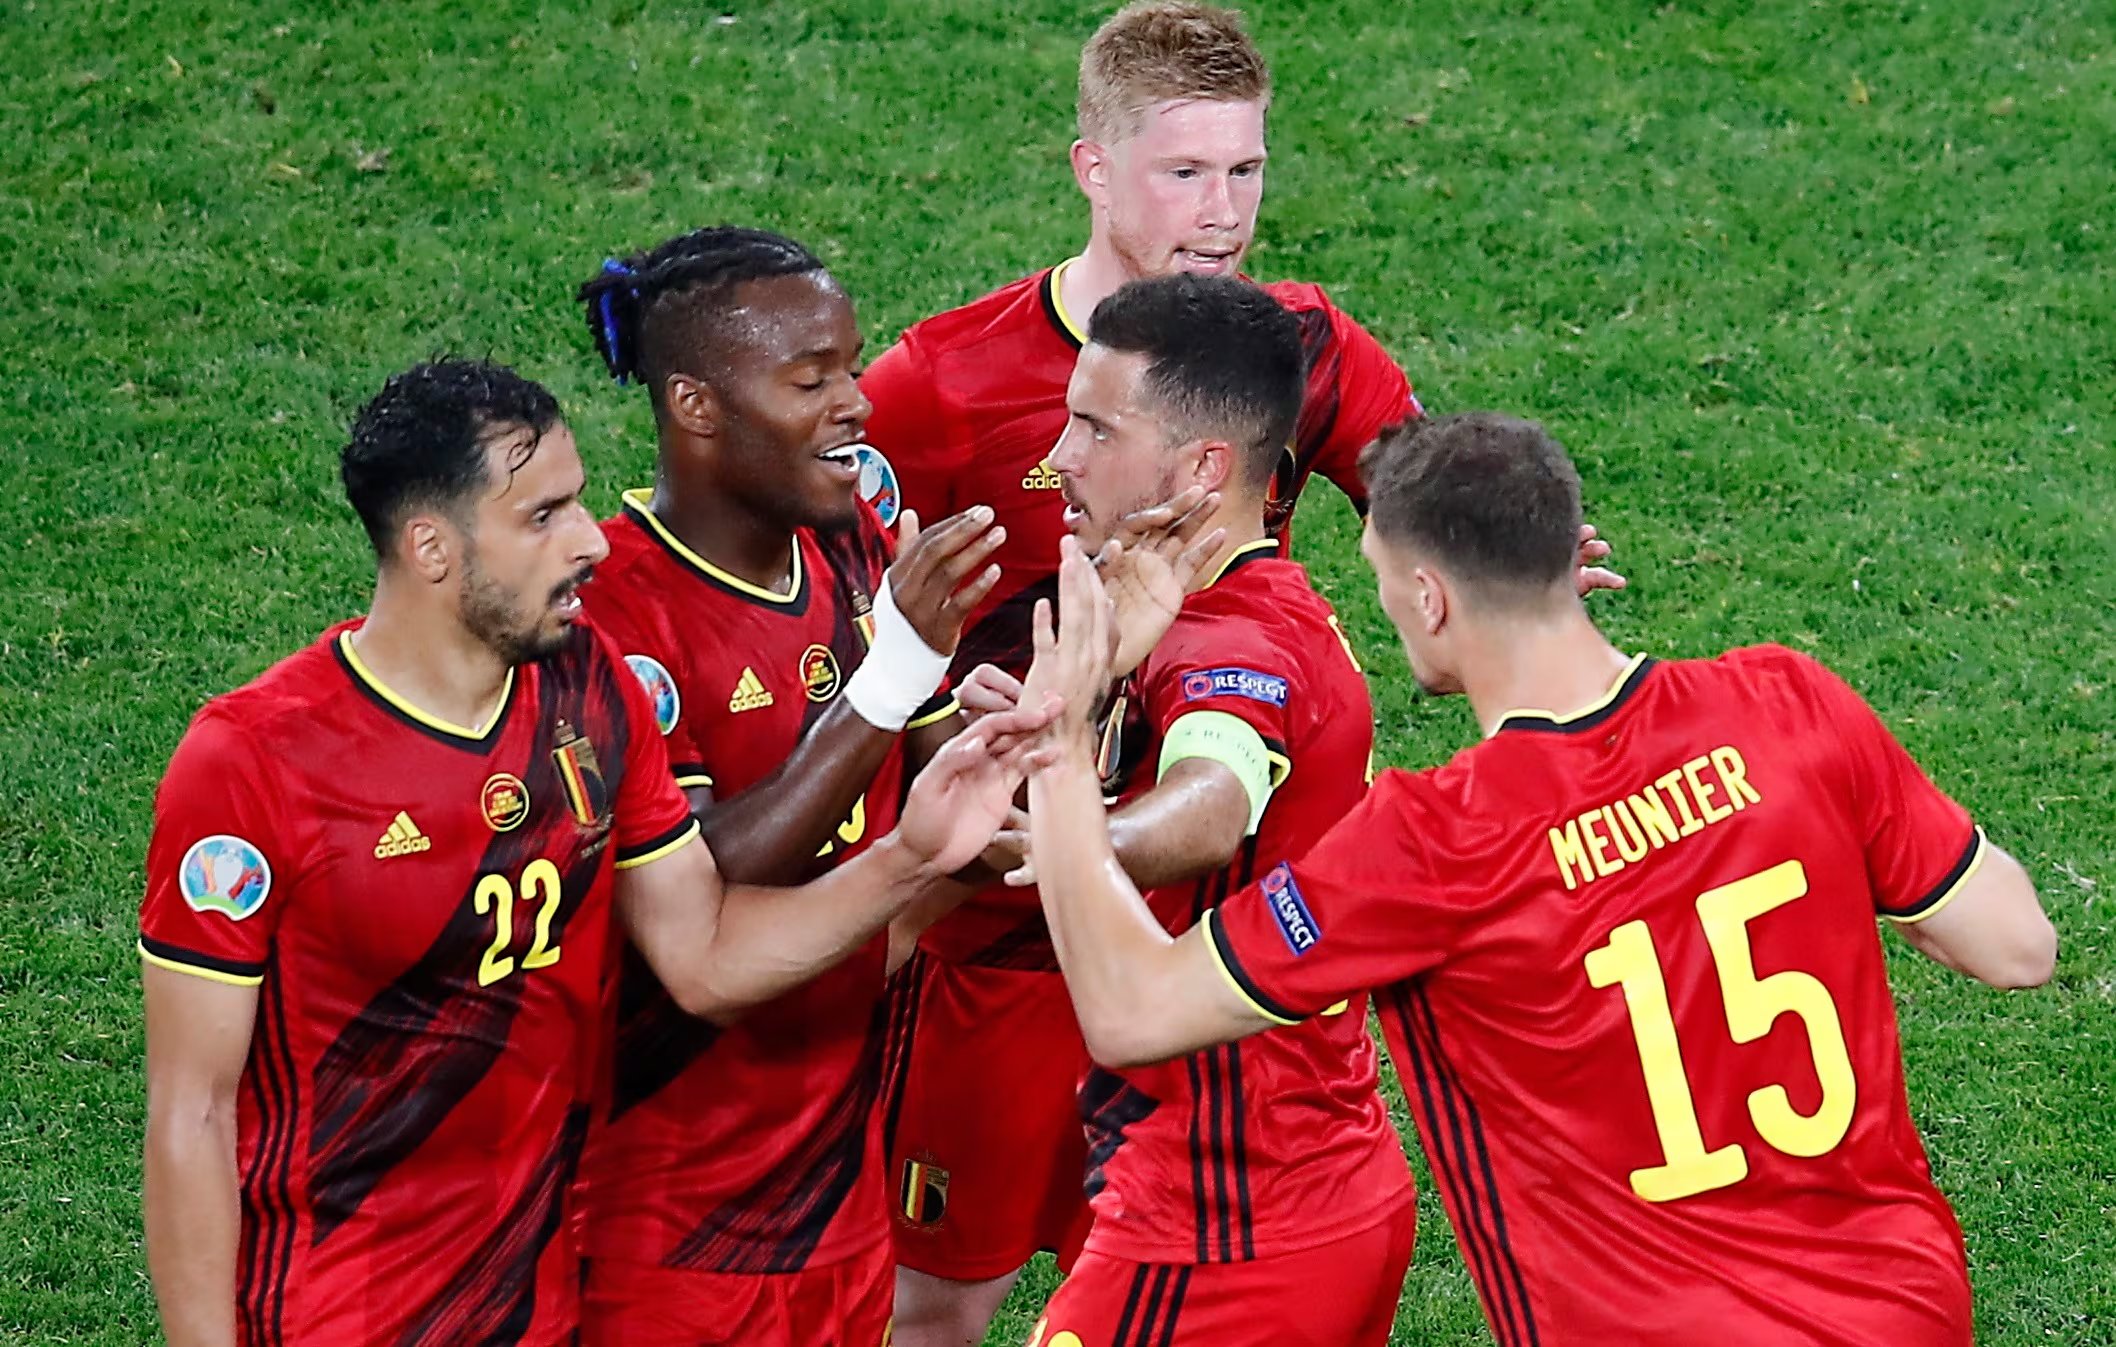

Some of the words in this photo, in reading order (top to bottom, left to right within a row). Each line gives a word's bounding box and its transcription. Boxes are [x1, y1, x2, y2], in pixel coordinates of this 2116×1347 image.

[1022, 474, 1061, 489] adid
[729, 691, 774, 713] adidas
[1215, 674, 1287, 699] RESPECT
[1548, 745, 1762, 890] MEUNIER
[374, 836, 431, 859] adidas
[474, 858, 561, 987] 22
[1275, 887, 1315, 949] RESPECT
[1584, 859, 1857, 1202] 15
